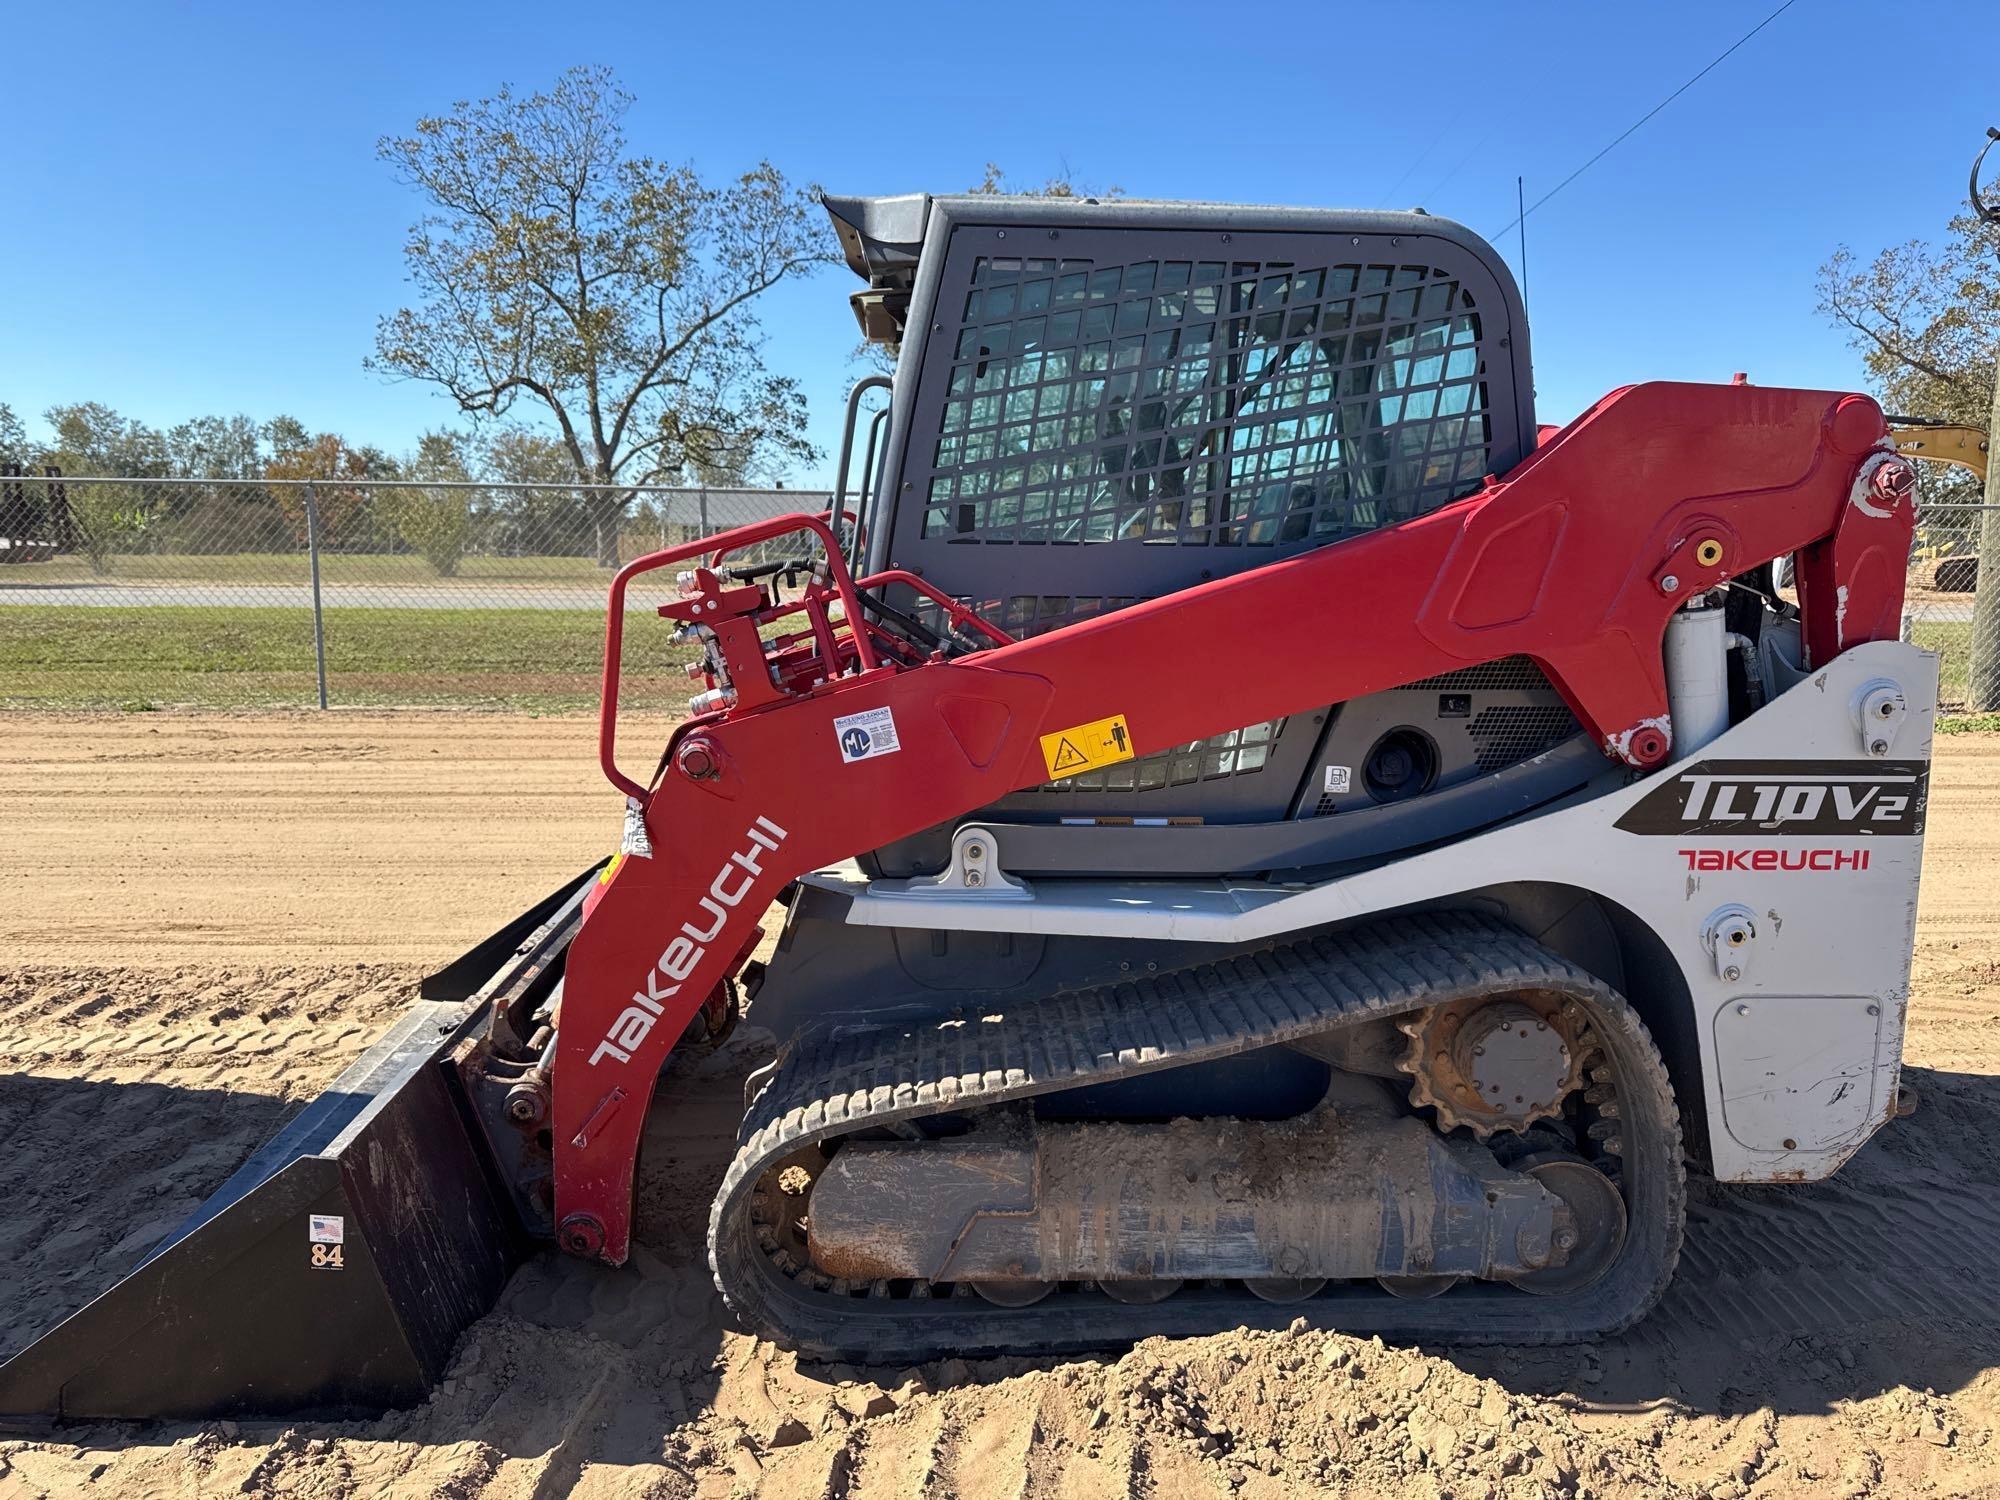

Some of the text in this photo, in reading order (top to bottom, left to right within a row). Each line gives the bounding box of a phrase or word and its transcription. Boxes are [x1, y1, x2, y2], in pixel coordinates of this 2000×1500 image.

[1900, 441, 1919, 451] CAT
[1678, 849, 1870, 871] TAKEUCHI
[588, 815, 788, 1067] TAKEUCHI
[311, 1243, 344, 1267] 84
